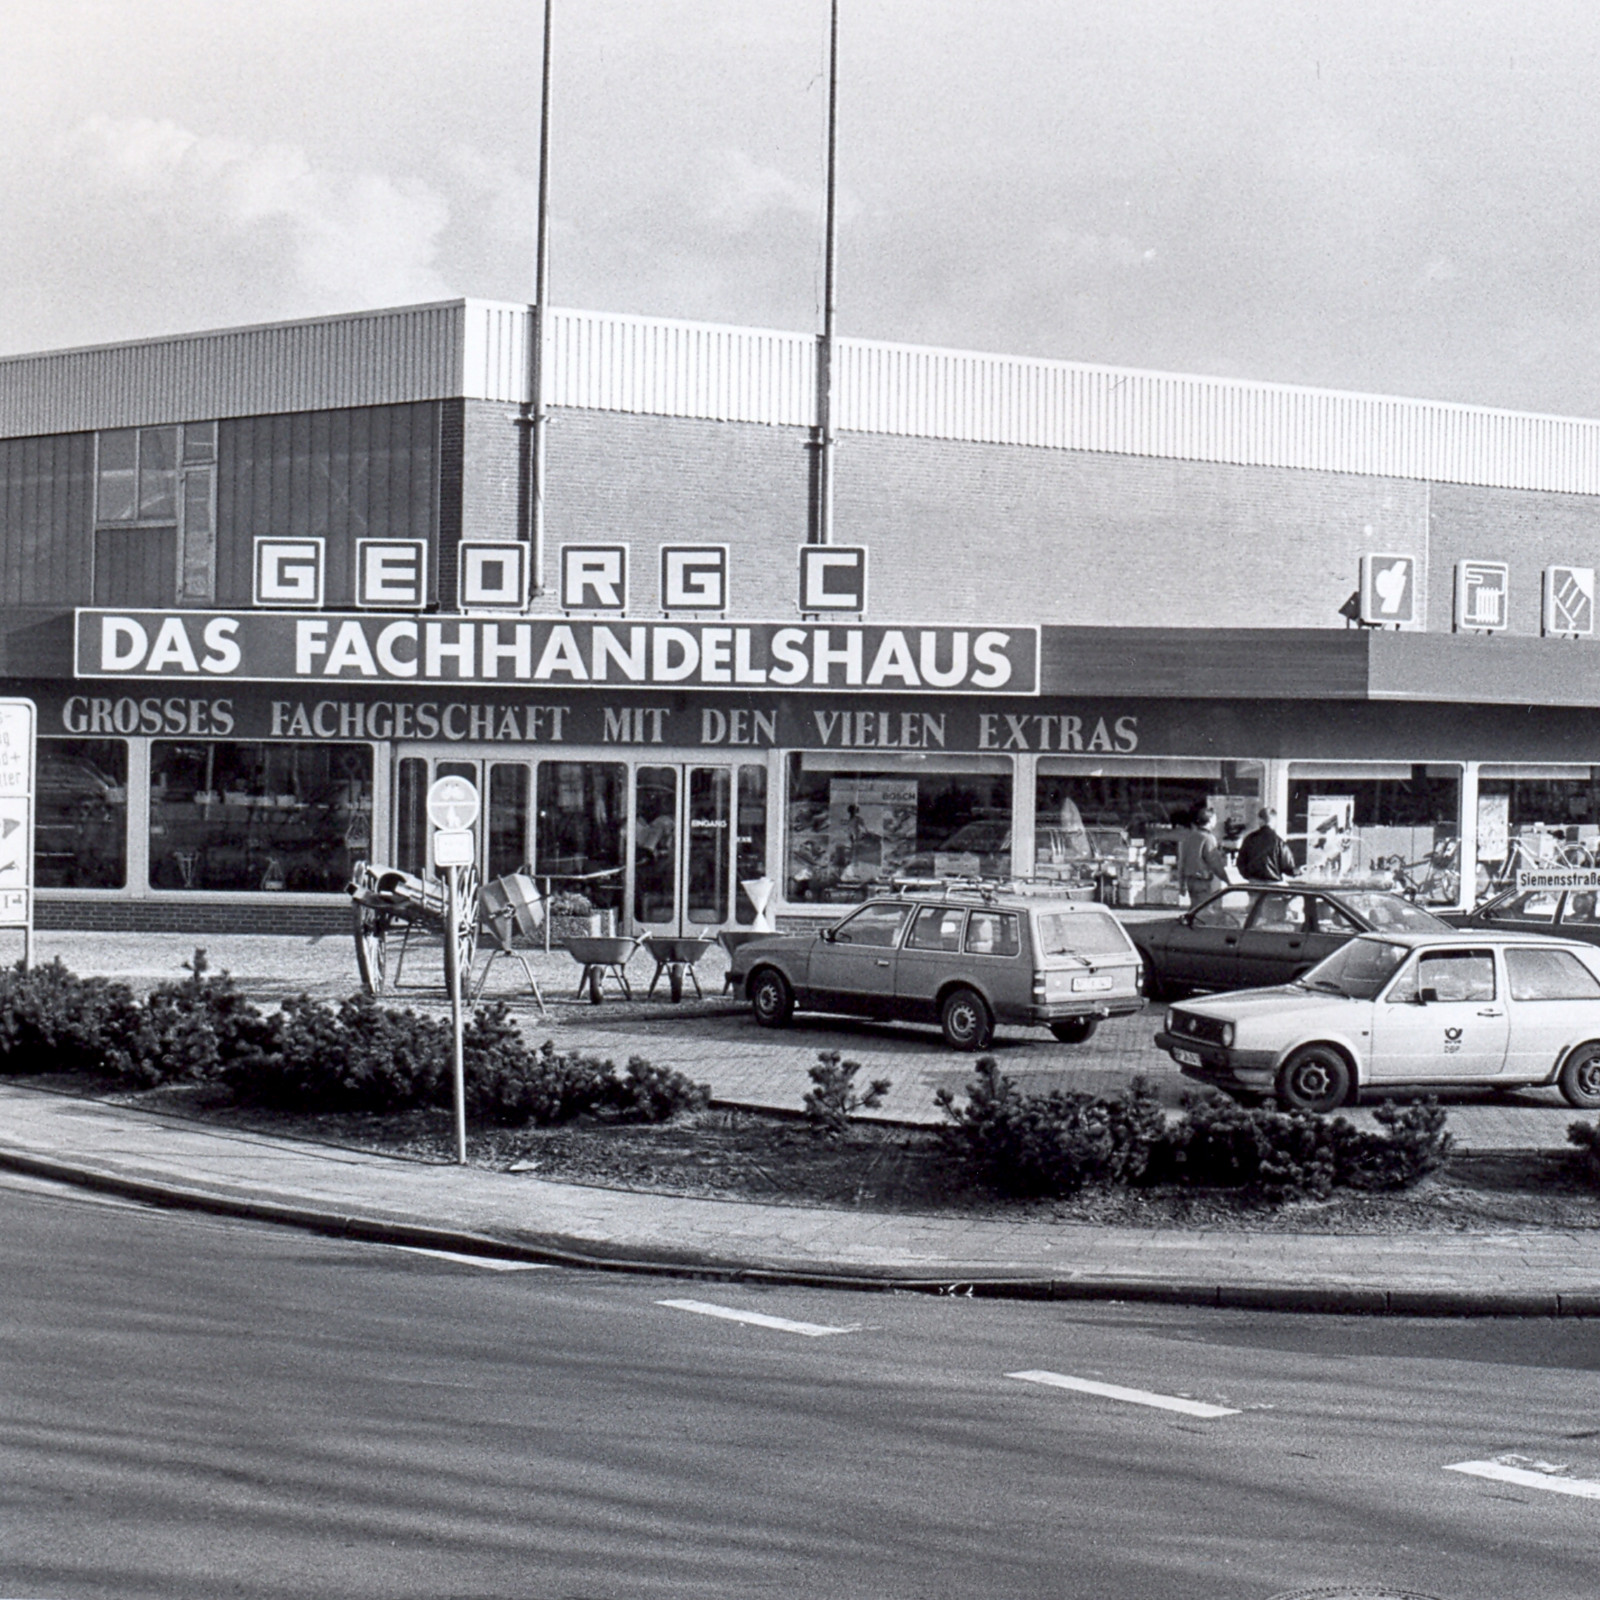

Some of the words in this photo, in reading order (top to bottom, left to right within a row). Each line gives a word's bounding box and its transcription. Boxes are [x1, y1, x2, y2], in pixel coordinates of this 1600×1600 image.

[260, 544, 722, 606] GEORG
[805, 552, 859, 606] C
[101, 616, 241, 673] DAS
[296, 620, 1012, 688] FACHHANDELSHAUS
[62, 697, 234, 735] GROSSES
[270, 701, 570, 741] FACHGESCHÄFT
[602, 707, 669, 743] MIT
[700, 708, 777, 745] DEN
[813, 710, 946, 748] VIELEN
[978, 714, 1138, 753] EXTRAS
